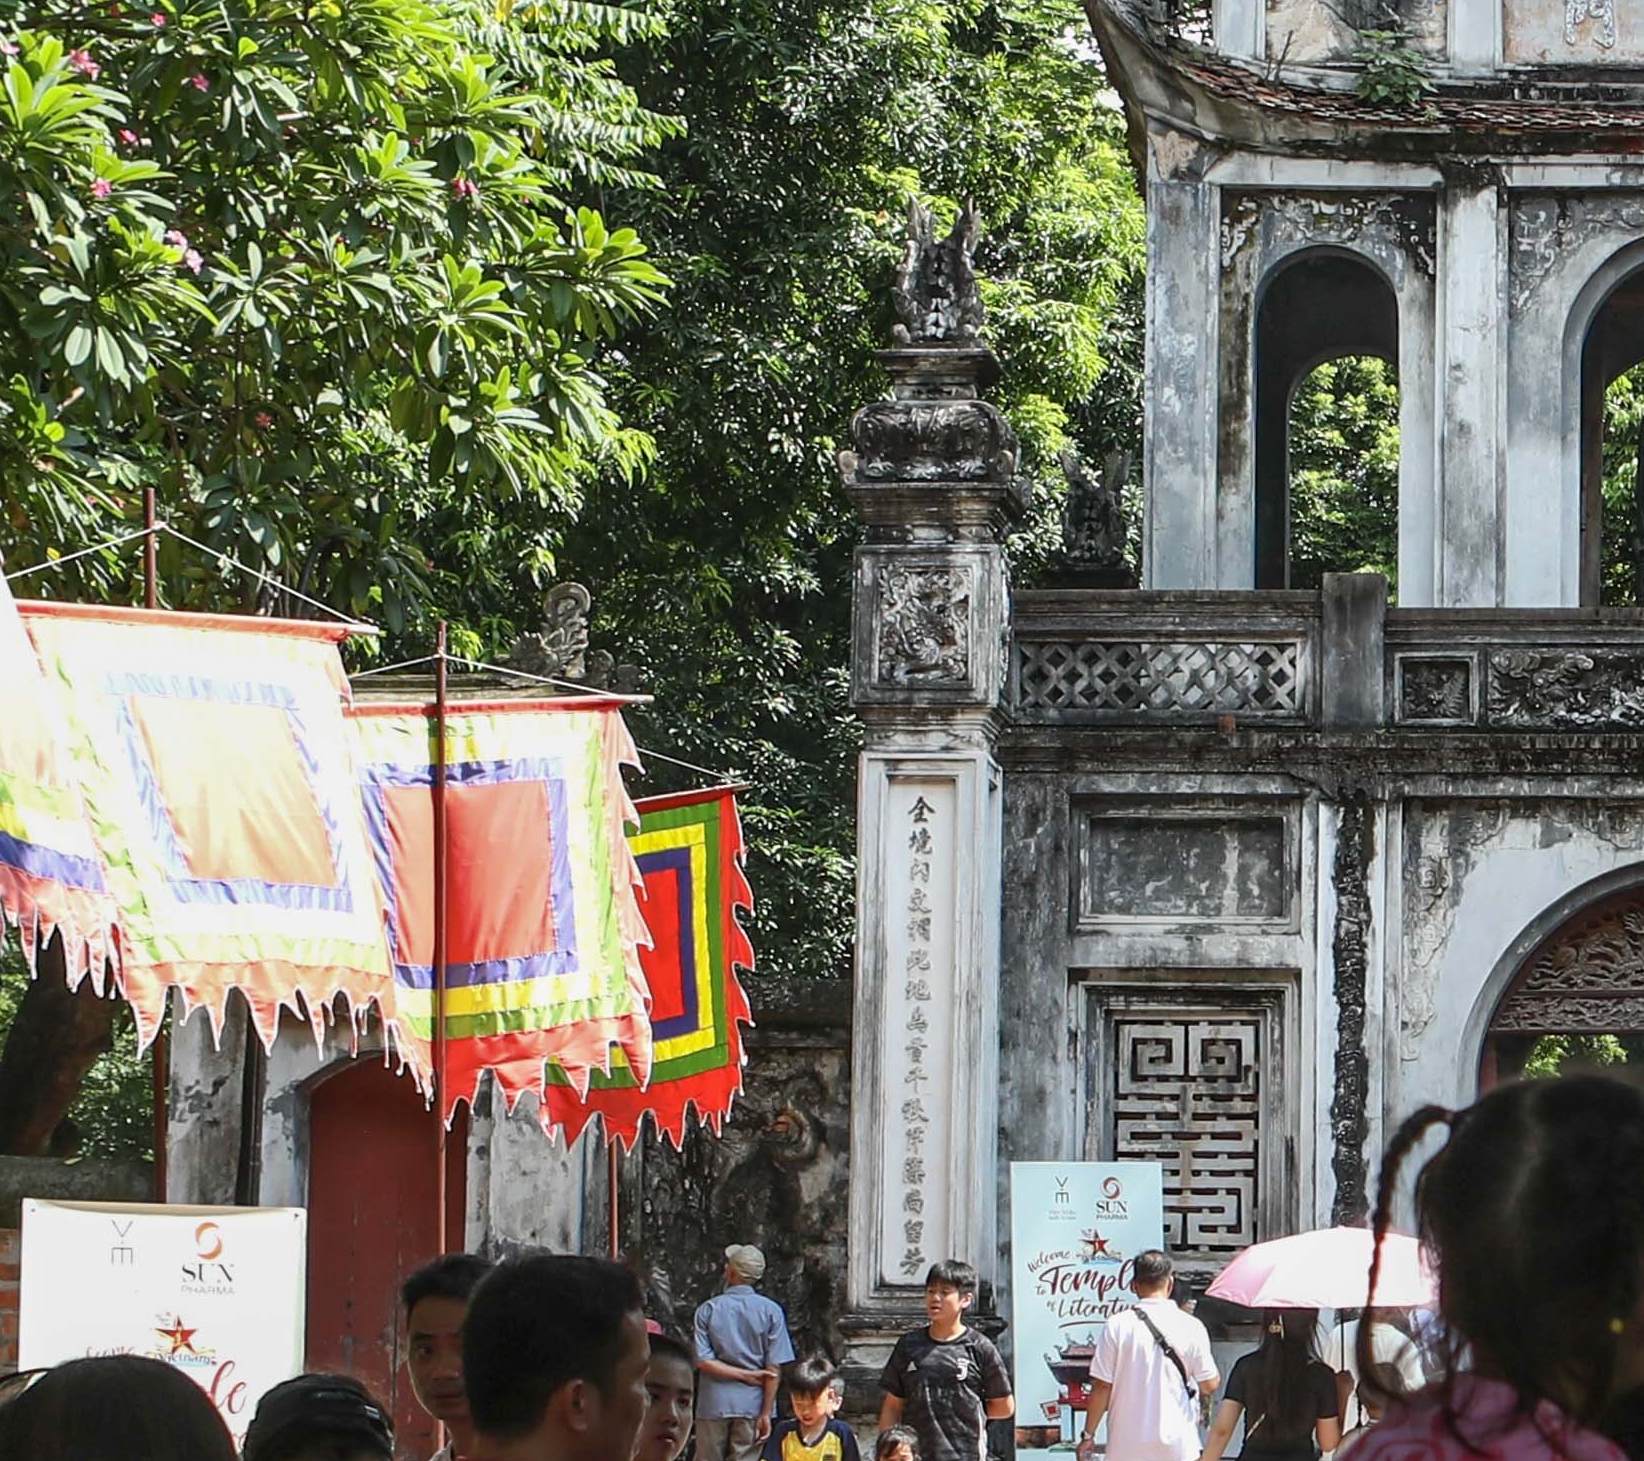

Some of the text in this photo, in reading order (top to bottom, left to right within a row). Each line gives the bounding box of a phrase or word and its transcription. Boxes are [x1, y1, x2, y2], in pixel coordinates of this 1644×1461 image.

[1095, 1200, 1128, 1214] SUN
[1027, 1249, 1071, 1273] Welcome
[181, 1263, 235, 1283] SUN
[1039, 1258, 1137, 1302] Templ
